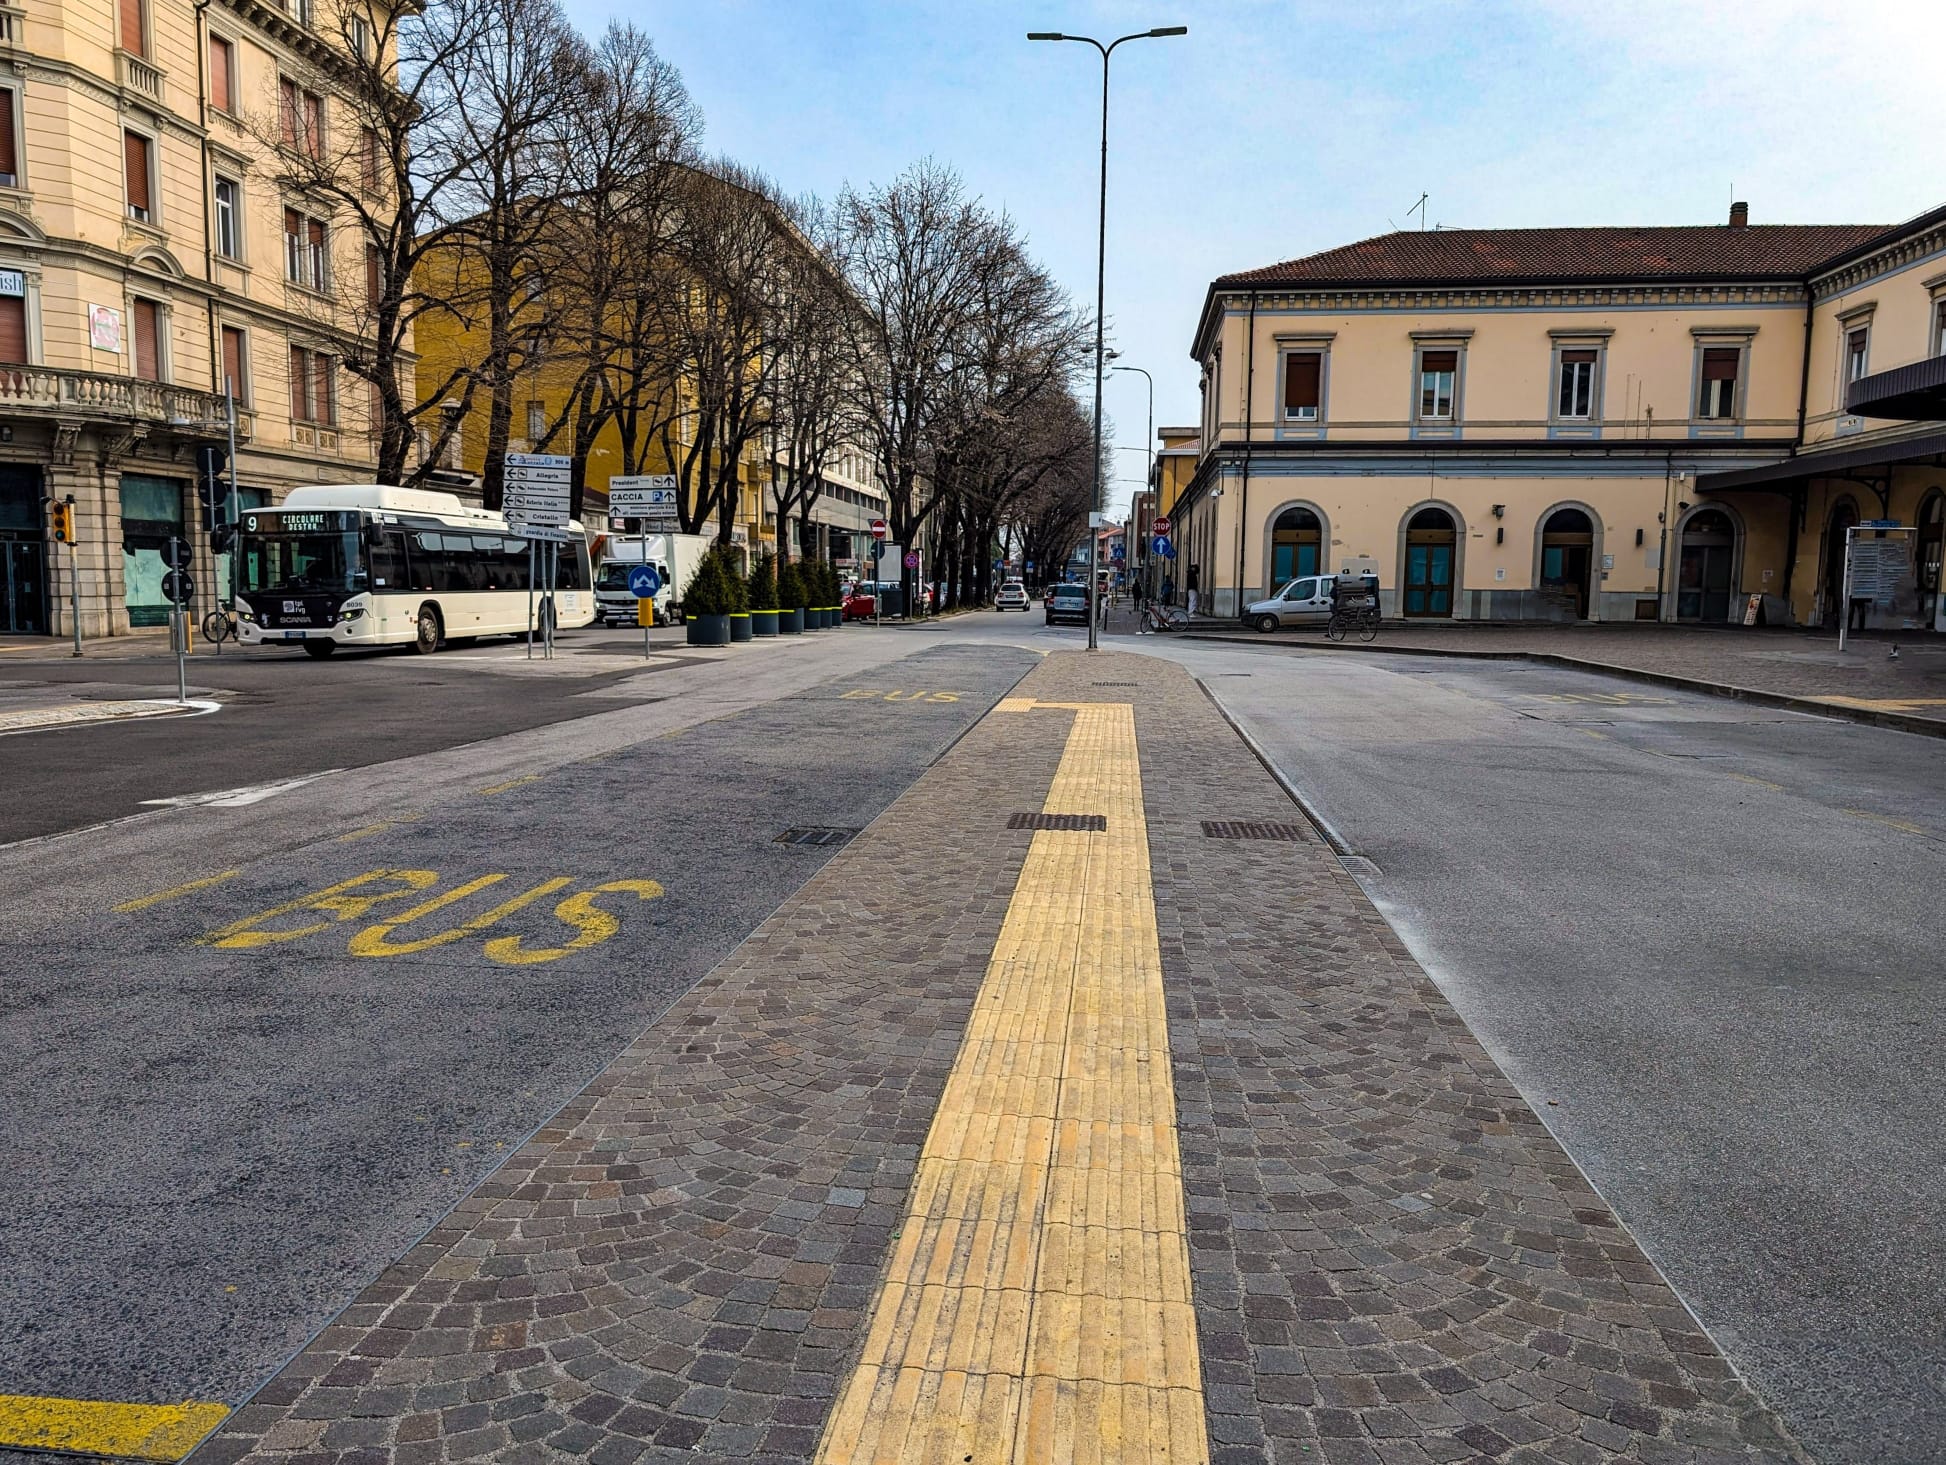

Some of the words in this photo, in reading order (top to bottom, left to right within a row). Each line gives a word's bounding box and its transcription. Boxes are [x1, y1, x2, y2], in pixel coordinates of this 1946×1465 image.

[248, 516, 257, 531] 9
[282, 514, 324, 524] CIRCOLARE
[288, 523, 317, 531] DESTRA
[1153, 522, 1171, 531] STOP
[294, 600, 304, 608] tpl
[280, 616, 312, 624] SCANIA
[838, 689, 960, 702] BUS
[195, 868, 665, 965] BUS
